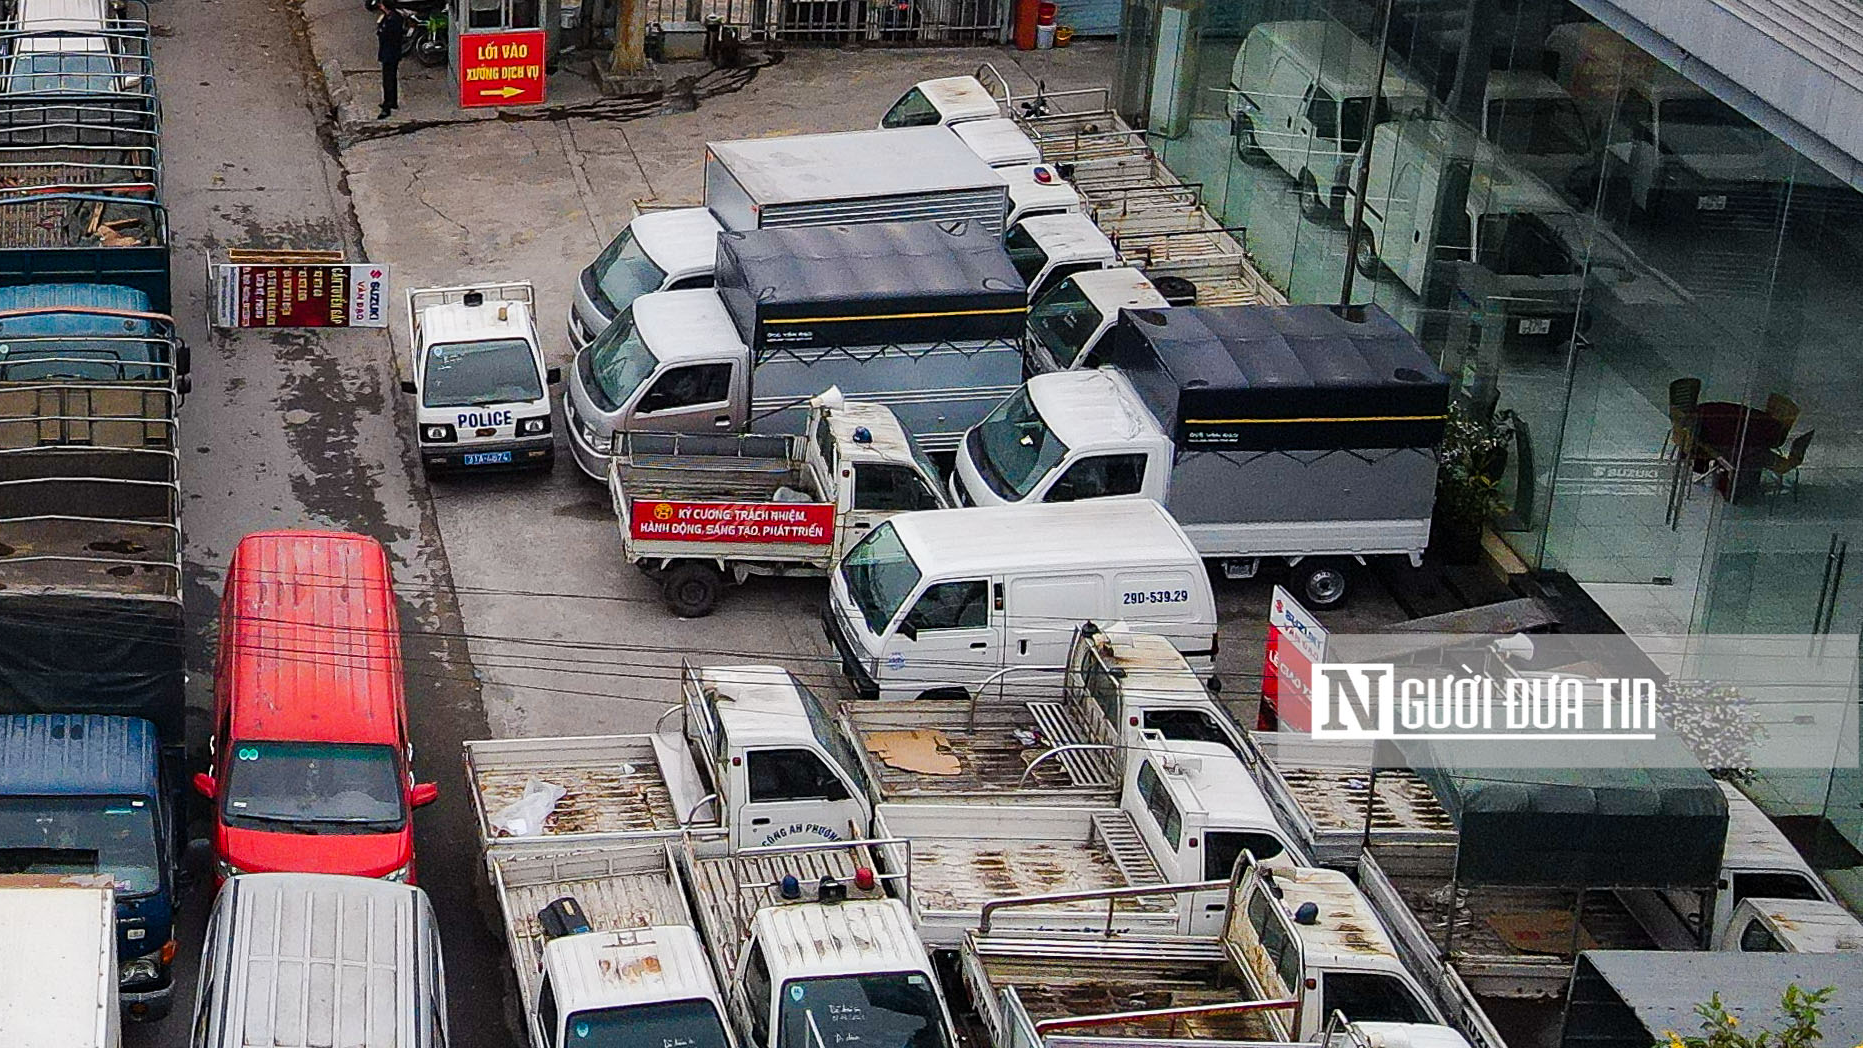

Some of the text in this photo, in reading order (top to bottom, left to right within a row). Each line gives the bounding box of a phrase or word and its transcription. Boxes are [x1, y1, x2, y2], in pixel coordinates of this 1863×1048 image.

[478, 40, 528, 60] LỐI VÀO
[501, 66, 525, 81] DỊCH
[526, 65, 540, 81] VỤ
[369, 282, 381, 321] SUZUKI
[457, 410, 513, 428] POLICE
[640, 520, 670, 533] HÀNH
[705, 523, 736, 536] SÁNG
[1123, 590, 1188, 604] 29D-539.29
